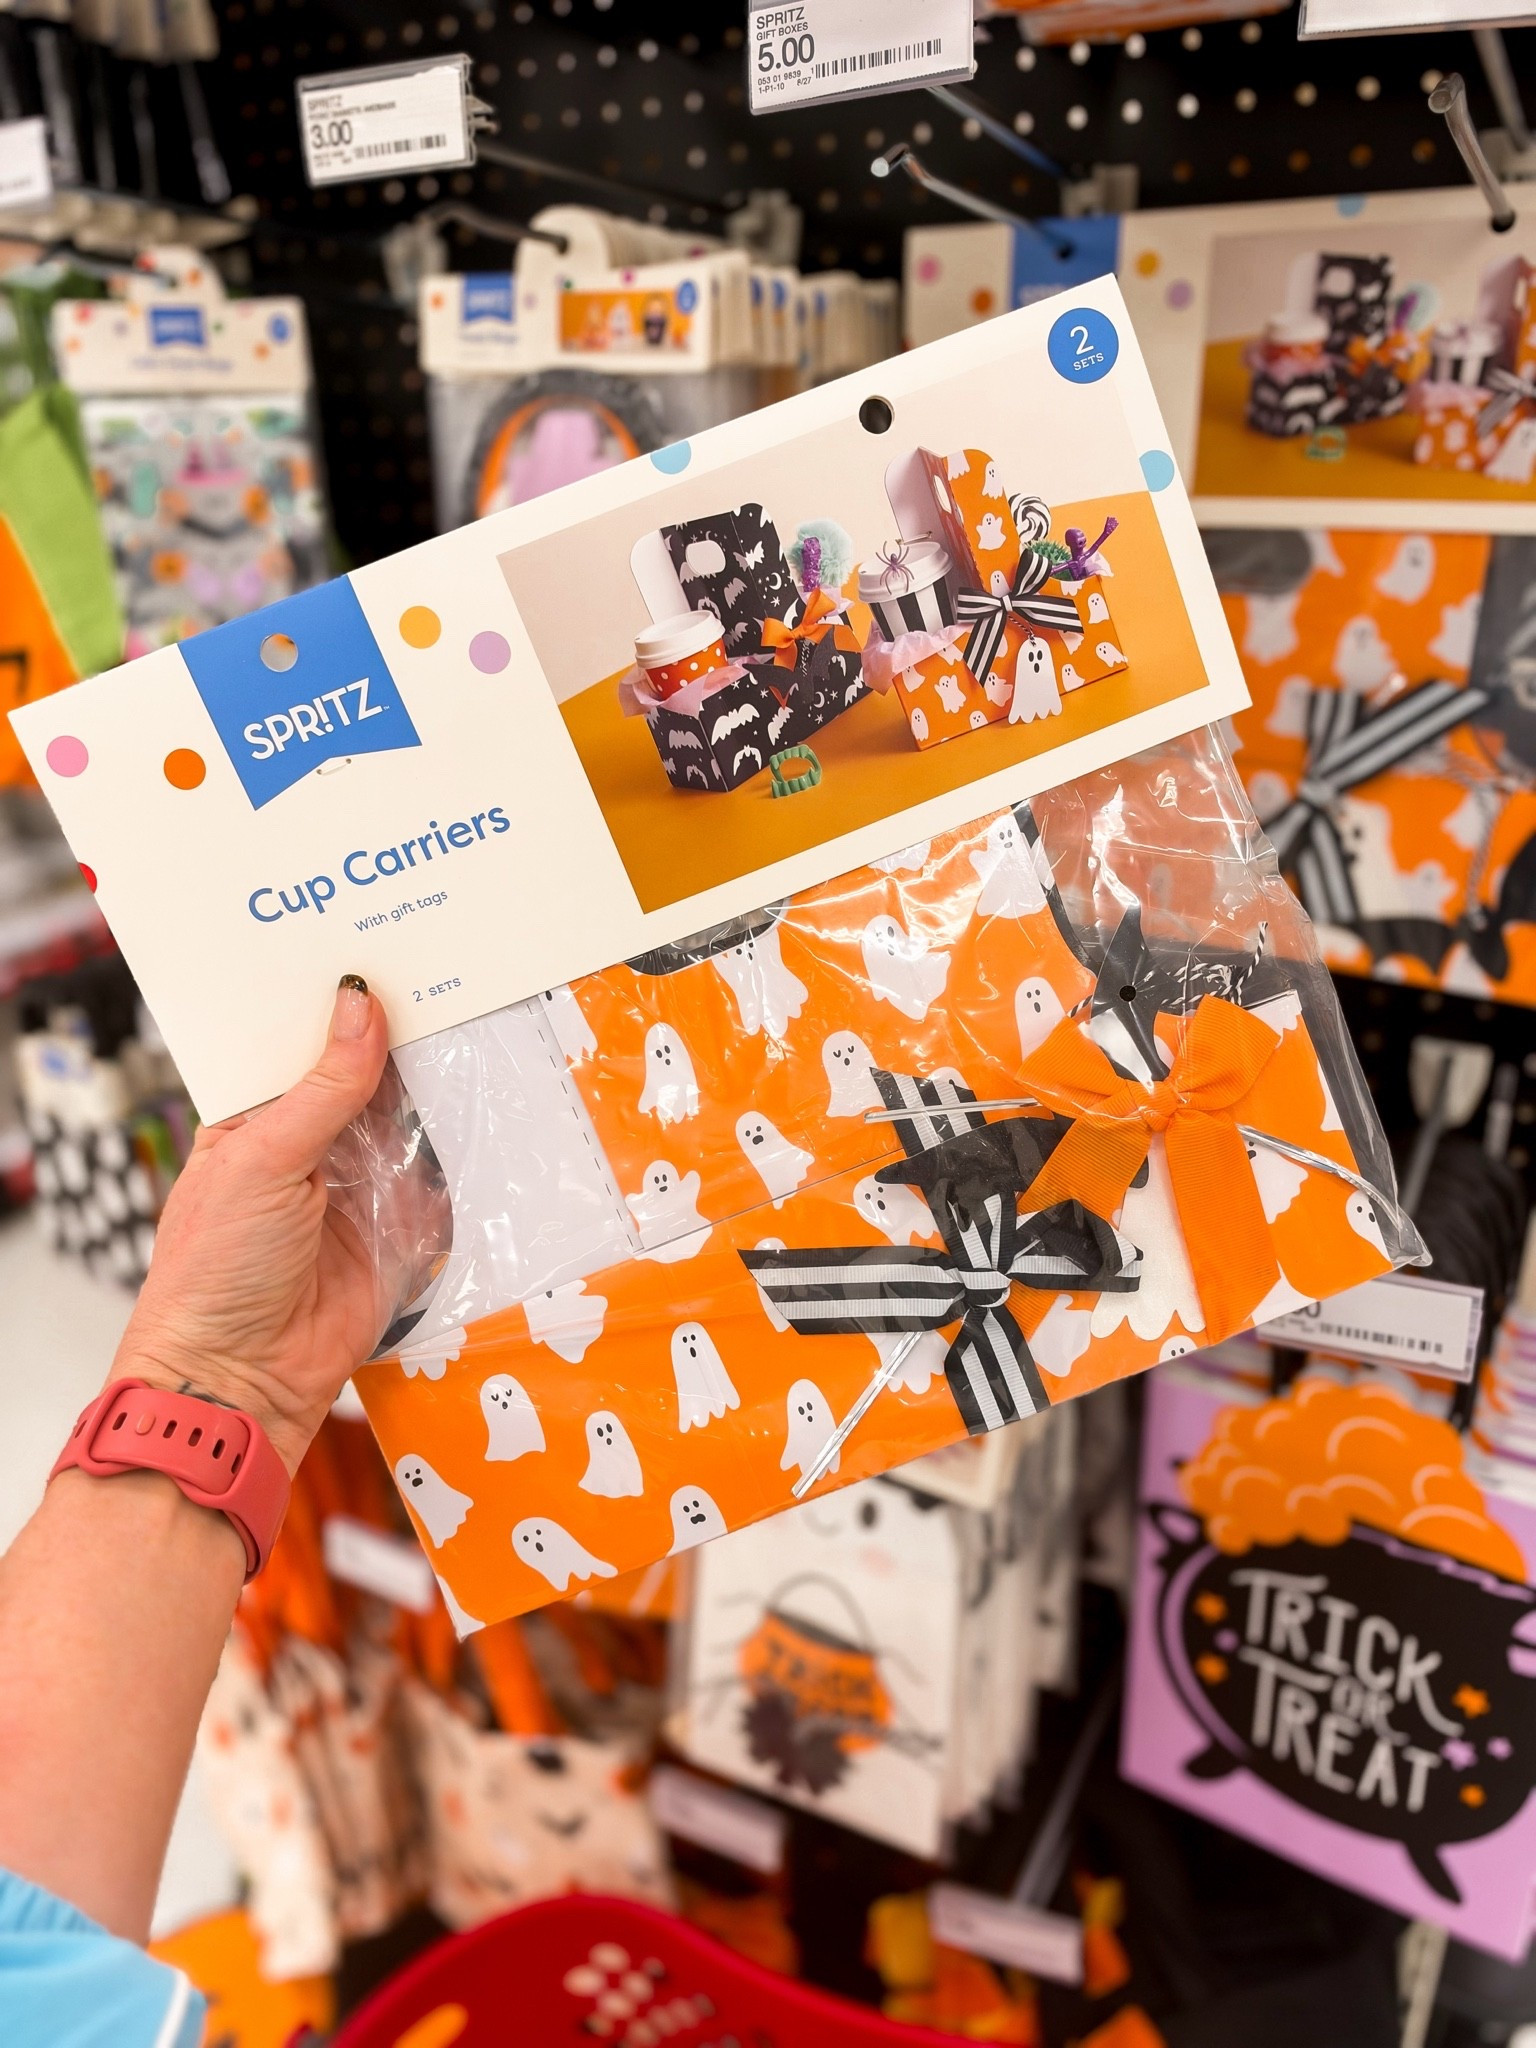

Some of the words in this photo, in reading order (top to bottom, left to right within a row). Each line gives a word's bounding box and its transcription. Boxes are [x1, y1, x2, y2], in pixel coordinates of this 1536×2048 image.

[756, 6, 805, 30] SPRITZ
[756, 29, 777, 41] GIFT
[778, 22, 809, 36] BOXES
[757, 33, 815, 73] 5.00
[757, 76, 771, 86] 053
[773, 74, 781, 83] 01
[784, 70, 802, 81] 9839
[310, 119, 353, 149] 3.00
[1070, 325, 1094, 355] 2
[1073, 352, 1104, 371] SETS
[248, 875, 336, 923] Cup
[343, 807, 511, 886] Carriers
[353, 912, 388, 933] With
[390, 901, 416, 922] gift
[416, 890, 449, 911] tags
[412, 990, 424, 1002] 2
[428, 977, 462, 997] SETS
[1230, 1569, 1464, 1737] TRICK
[1331, 1675, 1410, 1746] OR
[1239, 1646, 1441, 1813] TREAT
